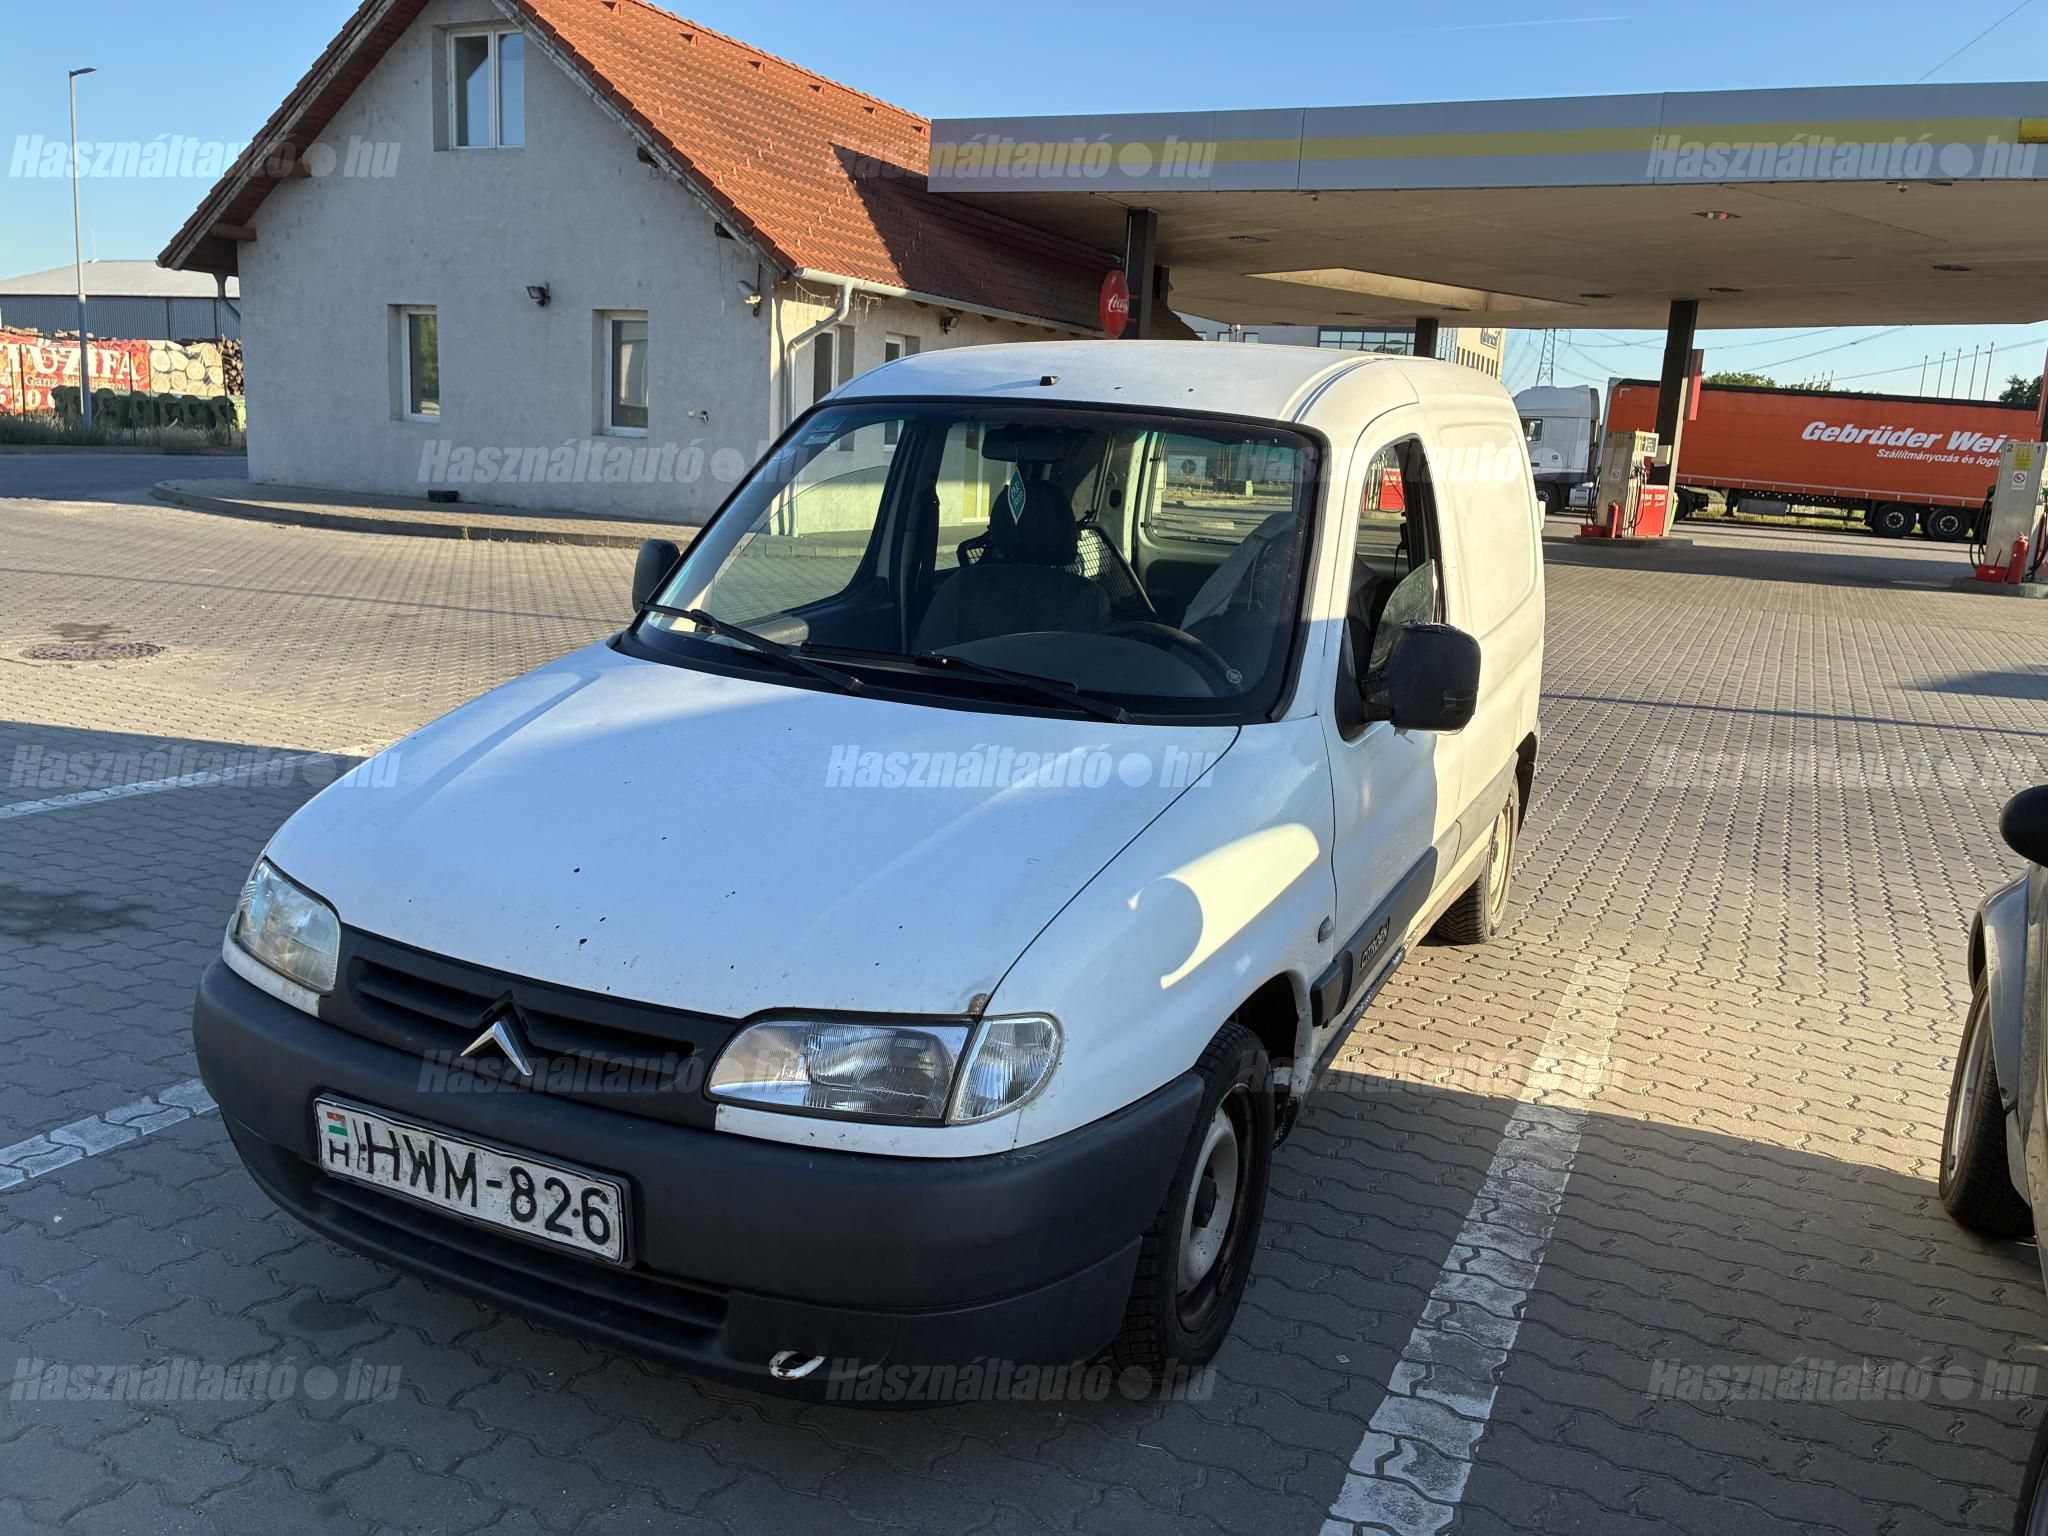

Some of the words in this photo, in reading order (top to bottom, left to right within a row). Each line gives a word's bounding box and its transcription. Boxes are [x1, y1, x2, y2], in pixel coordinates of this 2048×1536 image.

[1801, 421, 1943, 449] Gebrüder
[1948, 431, 2008, 453] Wei
[2006, 444, 2014, 452] 2
[1876, 449, 1959, 464] Szállítmányozás
[1961, 454, 1974, 465] és
[2036, 445, 2041, 454] 1
[329, 1138, 349, 1167] H
[364, 1121, 611, 1245] HWM-826
